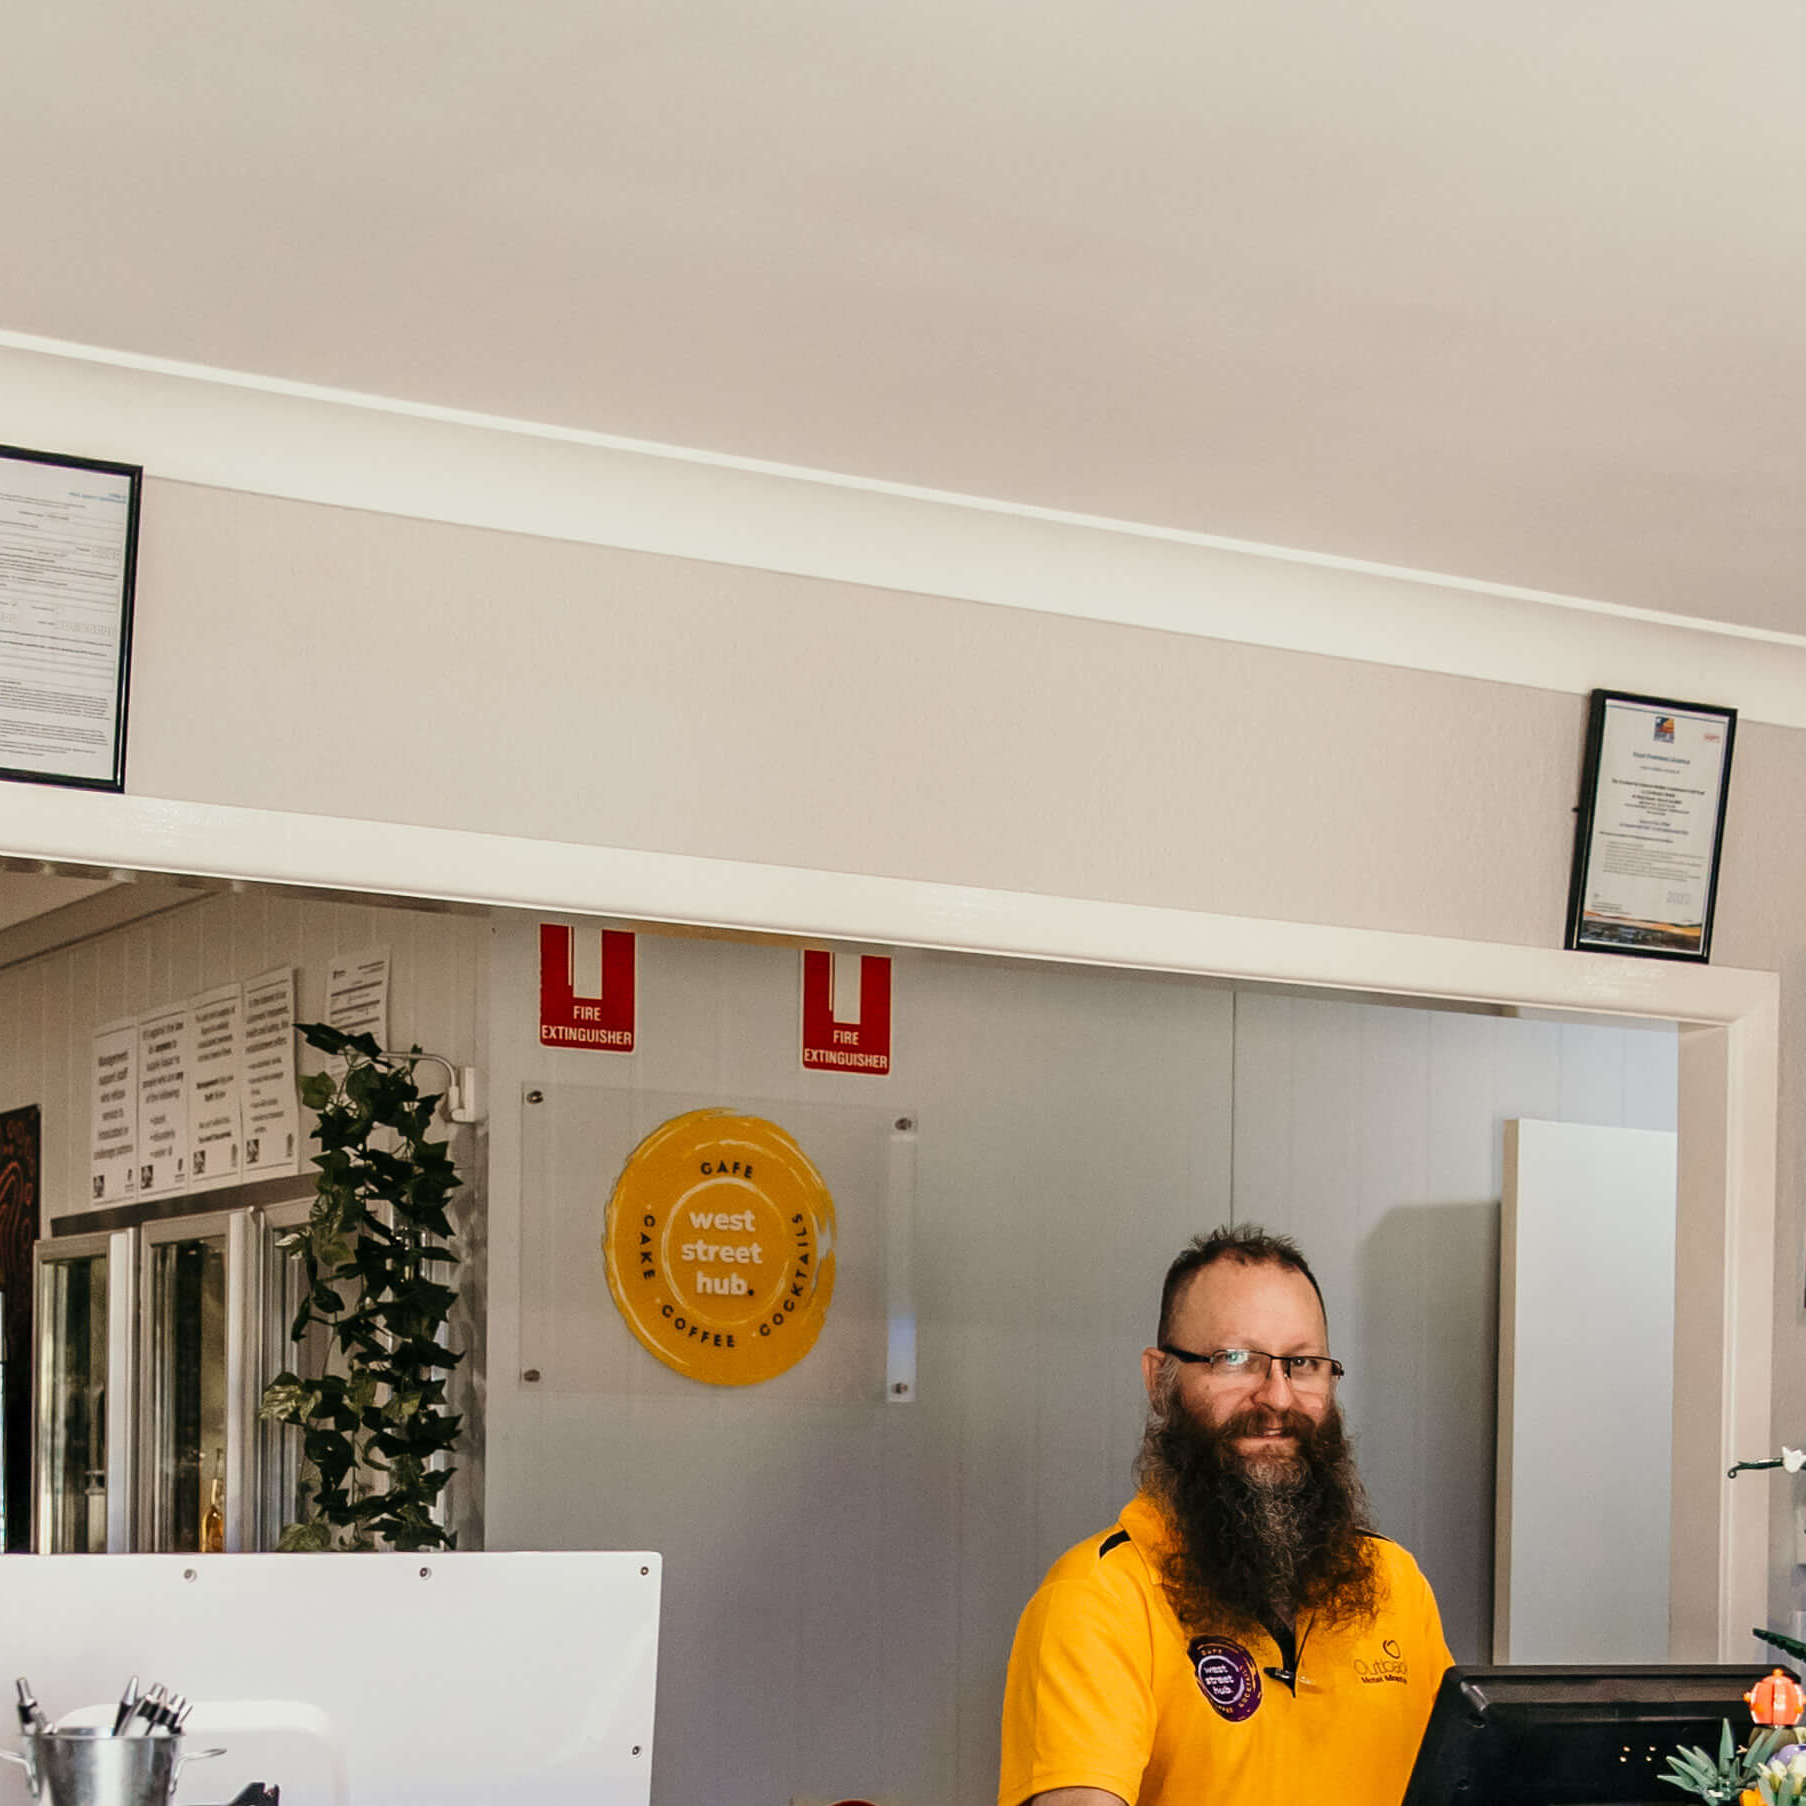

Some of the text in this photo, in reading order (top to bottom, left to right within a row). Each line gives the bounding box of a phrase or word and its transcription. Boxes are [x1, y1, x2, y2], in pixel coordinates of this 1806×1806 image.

[573, 1006, 601, 1022] FIRE
[542, 1024, 632, 1046] EXTINGUISHER
[833, 1030, 859, 1046] FIRE
[804, 1048, 888, 1069] EXTINGUISHER
[689, 1210, 755, 1232] west
[640, 1215, 656, 1280] CAKE
[681, 1239, 763, 1264] street
[758, 1213, 810, 1336] COCKTAILS
[661, 1304, 735, 1347] COFFEE
[1203, 1664, 1229, 1674] west
[1205, 1674, 1235, 1685] street
